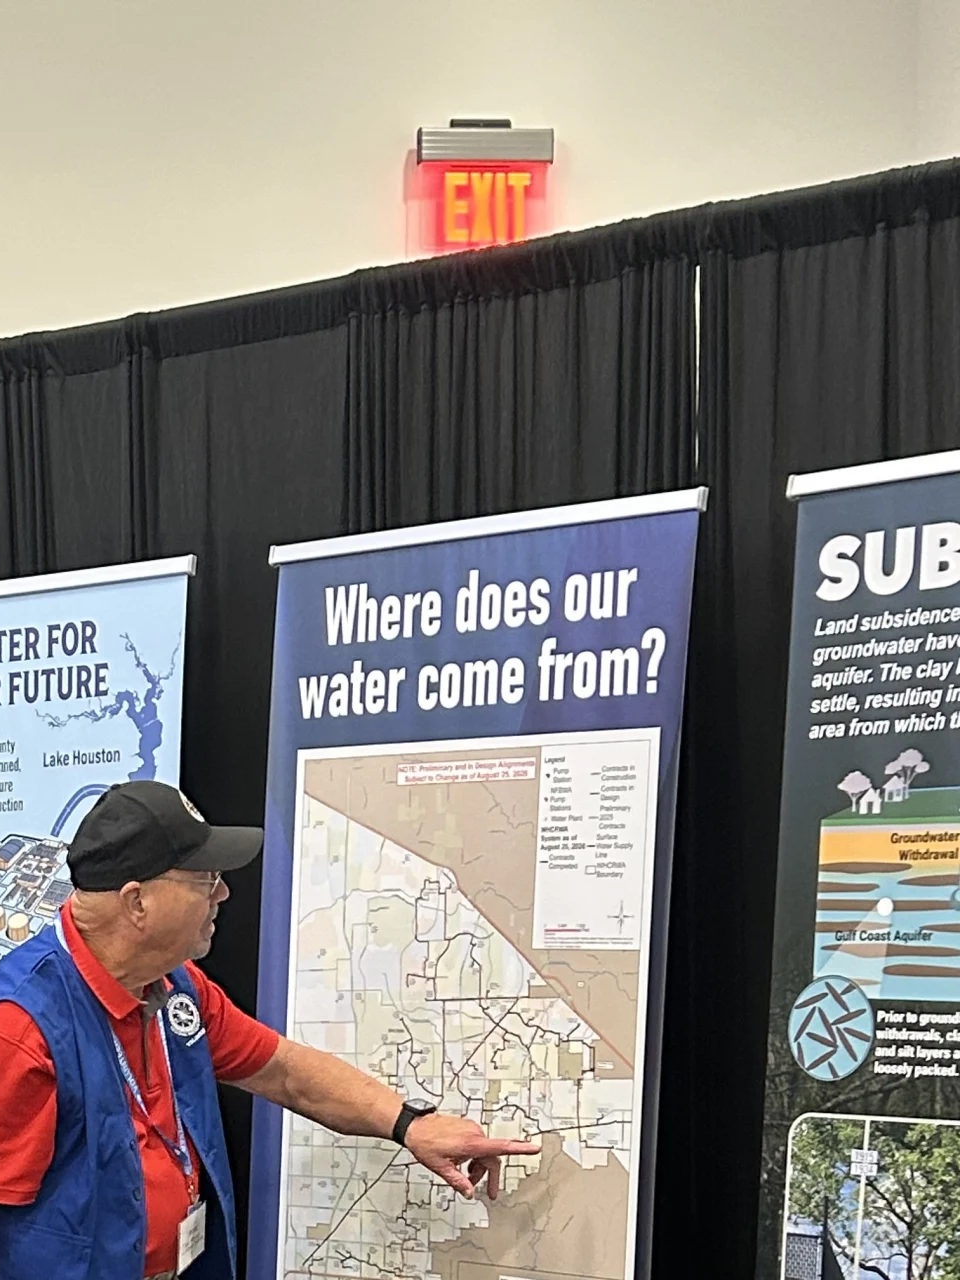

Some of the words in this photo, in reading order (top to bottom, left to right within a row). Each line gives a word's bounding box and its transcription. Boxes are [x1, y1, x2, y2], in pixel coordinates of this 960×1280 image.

[444, 172, 531, 242] EXIT
[325, 583, 441, 646] Where
[456, 569, 550, 634] does
[564, 567, 638, 623] our
[814, 614, 858, 637] Land
[860, 606, 960, 631] subsidence
[46, 620, 98, 657] FOR
[813, 636, 924, 666] groundwater
[8, 663, 110, 705] FUTURE
[298, 660, 406, 720] water
[417, 657, 524, 711] come
[538, 627, 666, 702] from?
[812, 666, 873, 691] aquifer.
[880, 663, 911, 682] The
[916, 659, 953, 681] clay
[810, 693, 860, 714] settle,
[864, 687, 943, 709] resulting
[809, 721, 844, 740] area
[848, 717, 890, 737] from
[894, 711, 946, 733] which
[43, 752, 70, 768] Lake
[72, 749, 121, 766] Houston
[890, 832, 960, 844] Groundwater
[899, 848, 959, 861] Withdrawal
[835, 930, 857, 942] Gulf
[860, 930, 890, 941] Coast
[893, 930, 933, 943] Aquifer
[877, 1010, 905, 1023] Prior
[906, 1012, 917, 1023] to
[876, 1028, 944, 1044] withdrawals,
[875, 1045, 897, 1057] and
[897, 1045, 915, 1058] silt
[916, 1045, 951, 1061] layers
[874, 1061, 913, 1078] loosely
[914, 1063, 959, 1078] packed.
